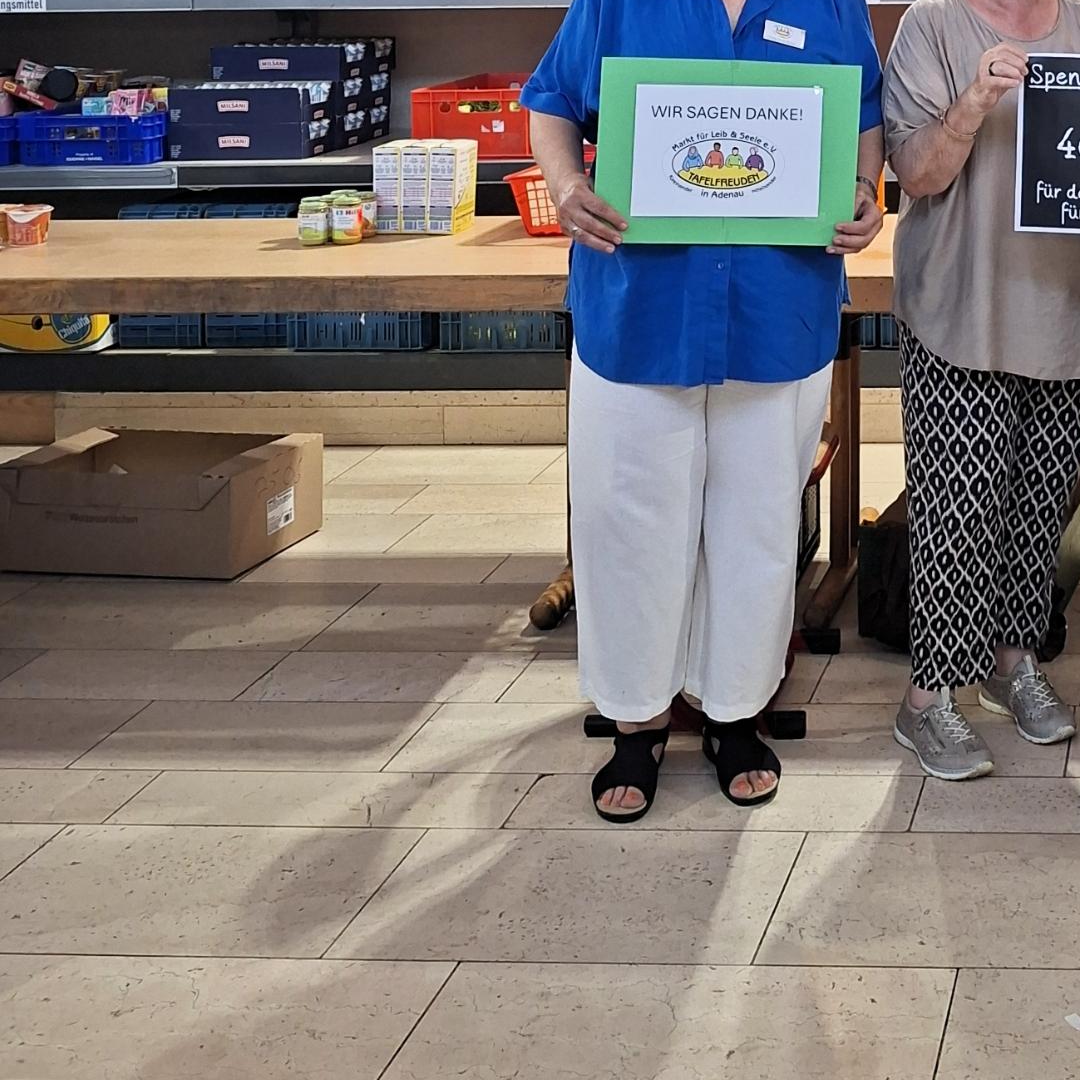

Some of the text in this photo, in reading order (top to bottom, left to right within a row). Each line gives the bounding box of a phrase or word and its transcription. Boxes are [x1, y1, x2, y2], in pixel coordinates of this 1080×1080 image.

[651, 105, 803, 121] WIR SAGEN DANKE!
[671, 136, 694, 152] Markt
[696, 132, 709, 140] für
[711, 130, 728, 138] Leib
[740, 132, 762, 145] Seele
[688, 172, 760, 187] TAFELFREUDEN
[701, 189, 744, 199] in Adenau
[1036, 180, 1062, 203] für
